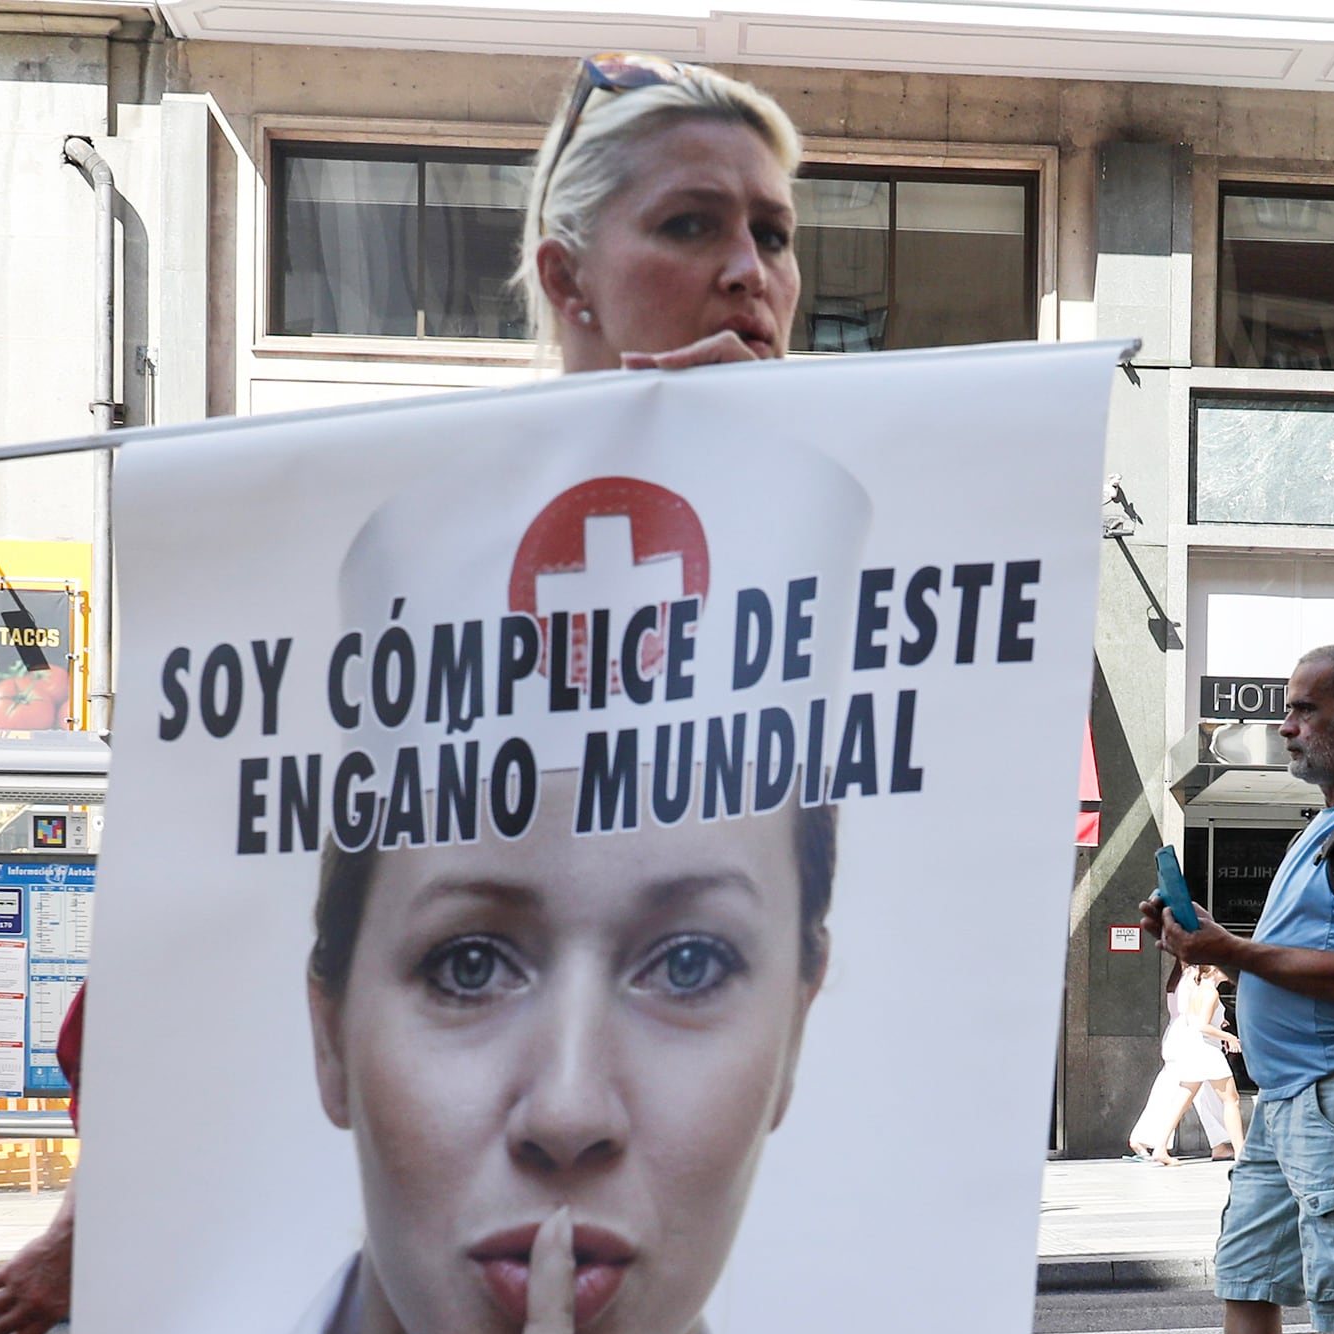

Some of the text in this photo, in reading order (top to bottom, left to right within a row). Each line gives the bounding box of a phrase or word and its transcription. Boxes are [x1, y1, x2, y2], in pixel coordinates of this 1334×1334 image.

[158, 559, 1042, 742] SOY CÓMPLICE DE ESTE
[1213, 682, 1290, 714] HOT
[236, 689, 925, 856] ENGAÑO MUNDIAL
